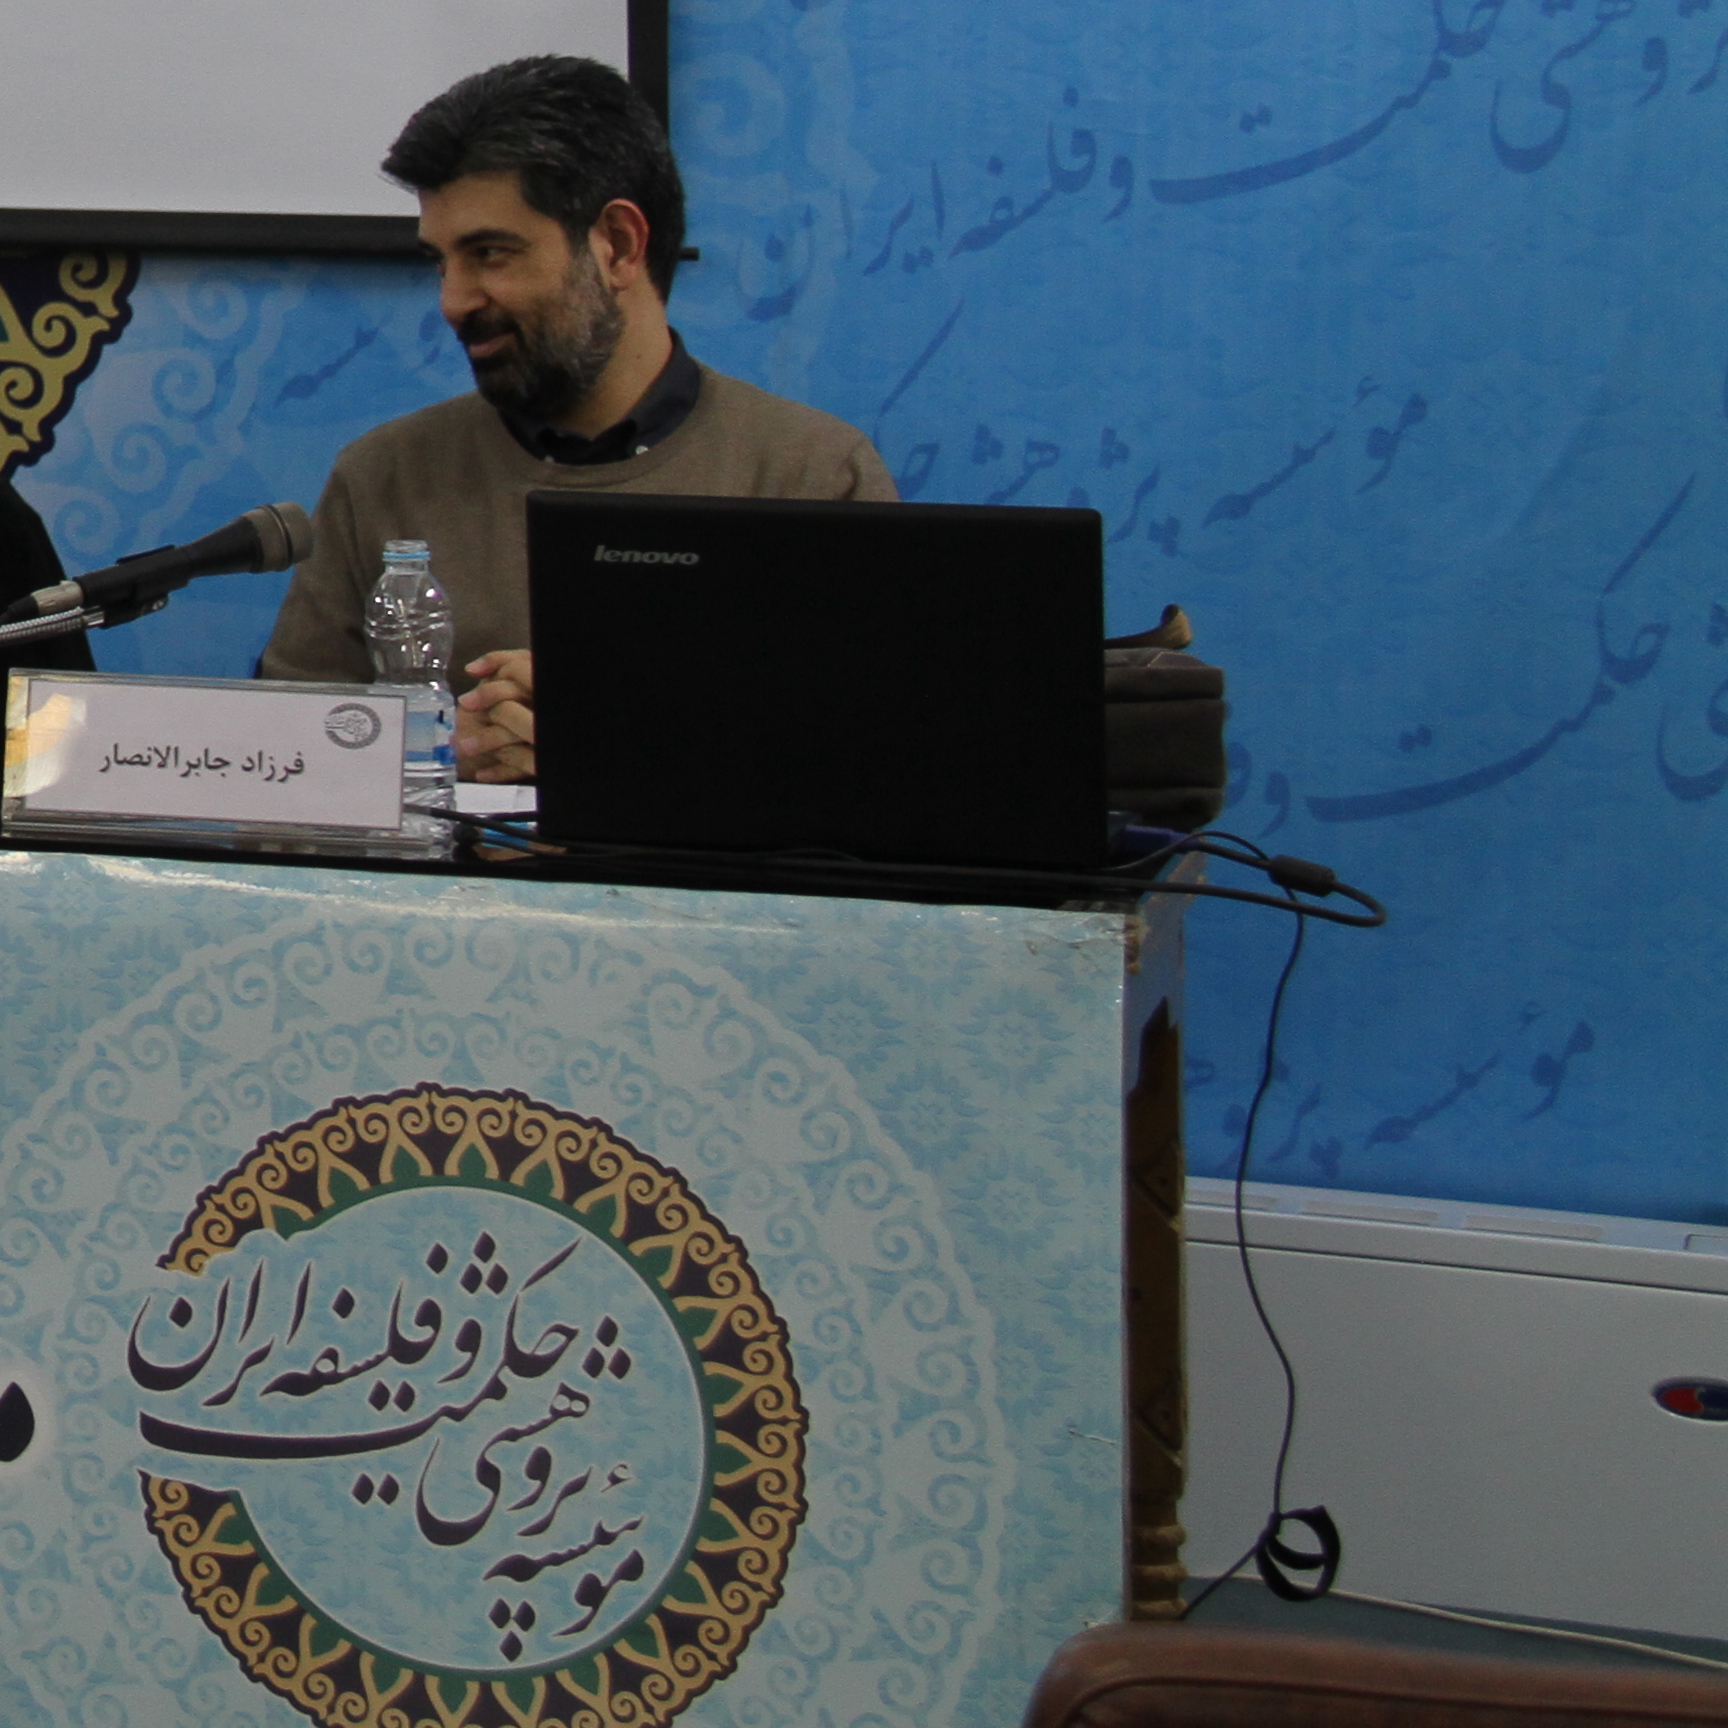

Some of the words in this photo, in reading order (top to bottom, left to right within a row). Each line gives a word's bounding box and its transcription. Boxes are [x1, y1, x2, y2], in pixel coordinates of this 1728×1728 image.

[946, 85, 1100, 260] فلسفه
[1101, 154, 1135, 223] و
[593, 544, 700, 566] lenovo
[1304, 471, 1696, 823] حکمت
[240, 749, 307, 784] فرزاد
[126, 1258, 312, 1408] ایران
